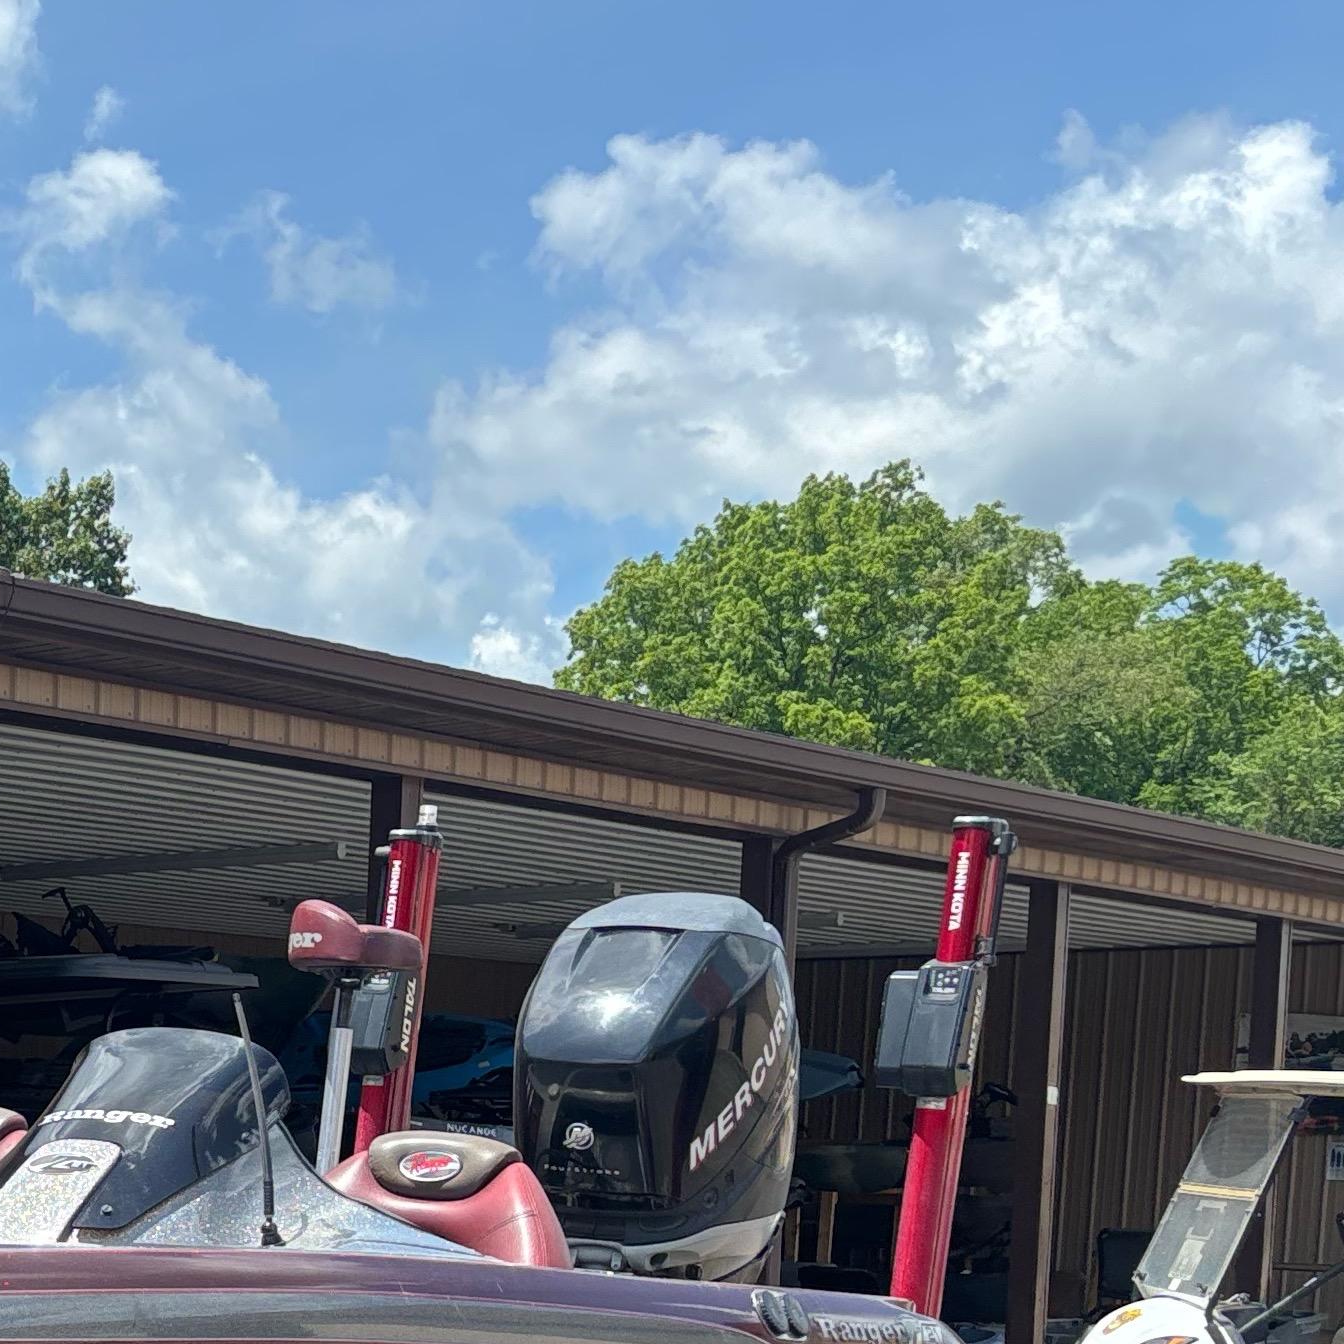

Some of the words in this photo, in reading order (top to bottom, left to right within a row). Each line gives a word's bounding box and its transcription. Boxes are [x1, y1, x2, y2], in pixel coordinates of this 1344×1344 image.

[400, 977, 417, 1053] TALON
[38, 1109, 176, 1129] Ranger
[689, 1001, 789, 1172] MERCURY
